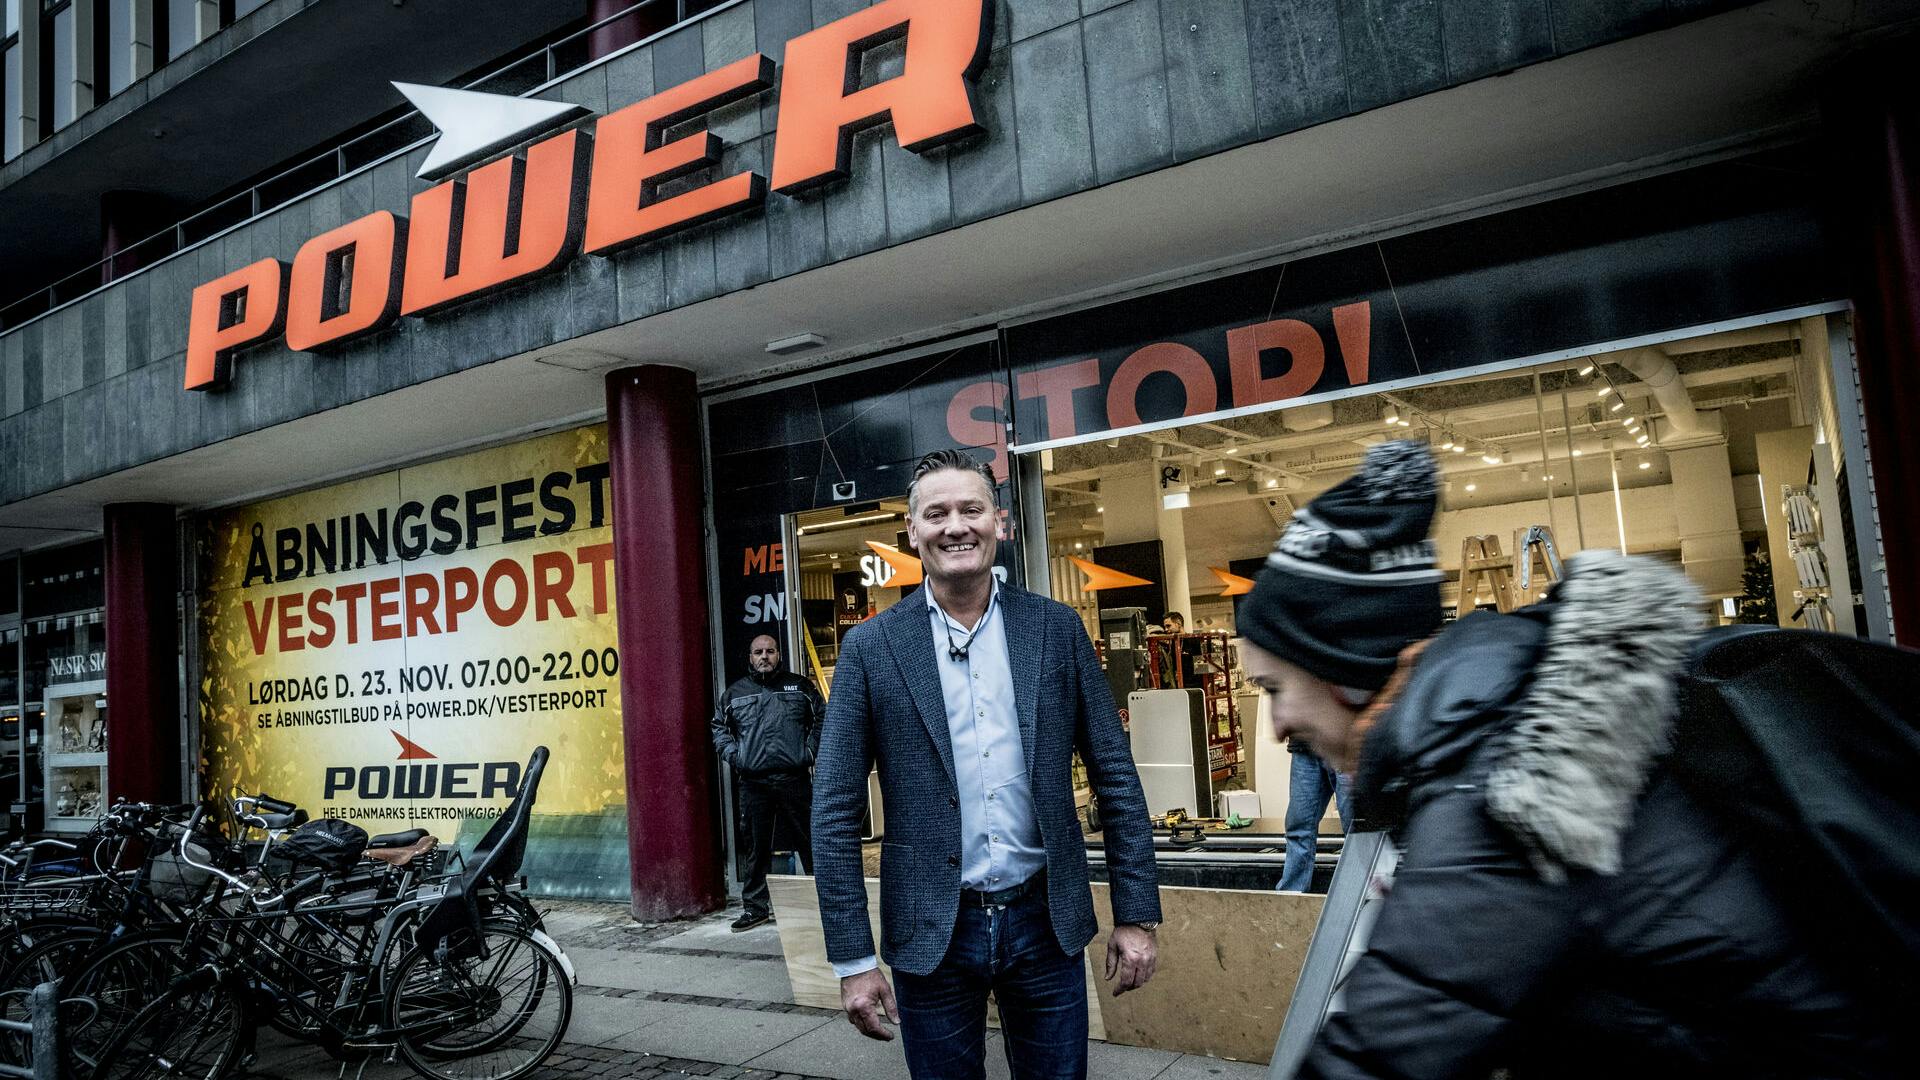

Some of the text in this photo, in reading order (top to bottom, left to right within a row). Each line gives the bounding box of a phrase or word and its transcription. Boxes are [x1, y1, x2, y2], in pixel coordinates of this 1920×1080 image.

[185, 0, 993, 391] POWER
[241, 461, 610, 588] ÅBNINGSFEST
[860, 554, 897, 587] SU
[244, 542, 618, 656] VESTERPORT
[743, 592, 790, 624] SN
[50, 655, 86, 676] NASIR
[248, 647, 619, 705] LØRDAG D. 23. NOV. 07.00-22.00
[258, 689, 607, 728] SE ÅBNINGSTILBUD PÅ POWER.DK/VESTERPORT
[323, 761, 521, 800] POWER
[323, 807, 506, 820] HELE DANMARKS ELEKTRONIKGIGA
